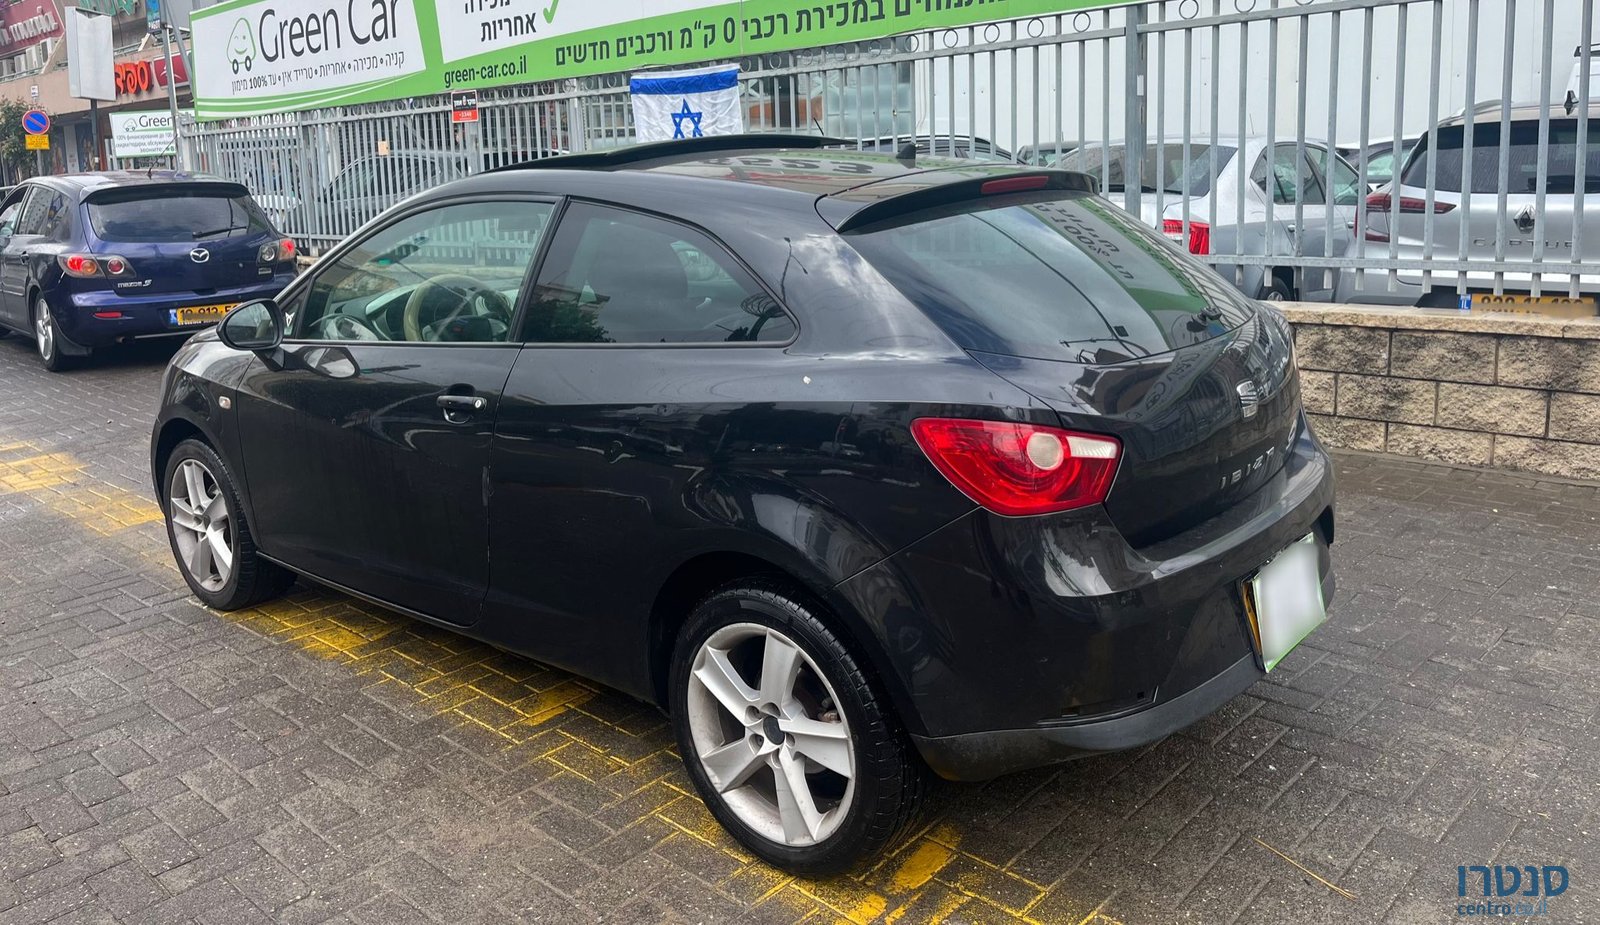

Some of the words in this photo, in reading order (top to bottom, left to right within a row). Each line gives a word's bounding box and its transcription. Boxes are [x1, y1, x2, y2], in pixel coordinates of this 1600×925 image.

[481, 12, 537, 42] אחריות
[742, 13, 788, 40] רכבי
[796, 0, 885, 33] במכירת
[259, 8, 341, 62] Green
[348, 0, 397, 45] Car
[723, 17, 736, 43] 0
[556, 39, 610, 66] חדשים
[616, 30, 673, 57] ורכבים
[319, 61, 347, 78] אחריות
[353, 55, 378, 72] מכירה
[385, 51, 405, 69] קניה
[444, 54, 527, 88] green-car.co.il
[249, 75, 268, 89] 100%
[267, 73, 277, 86] עד
[281, 70, 293, 87] אין
[293, 67, 314, 81] טרייד
[231, 79, 248, 96] מימון
